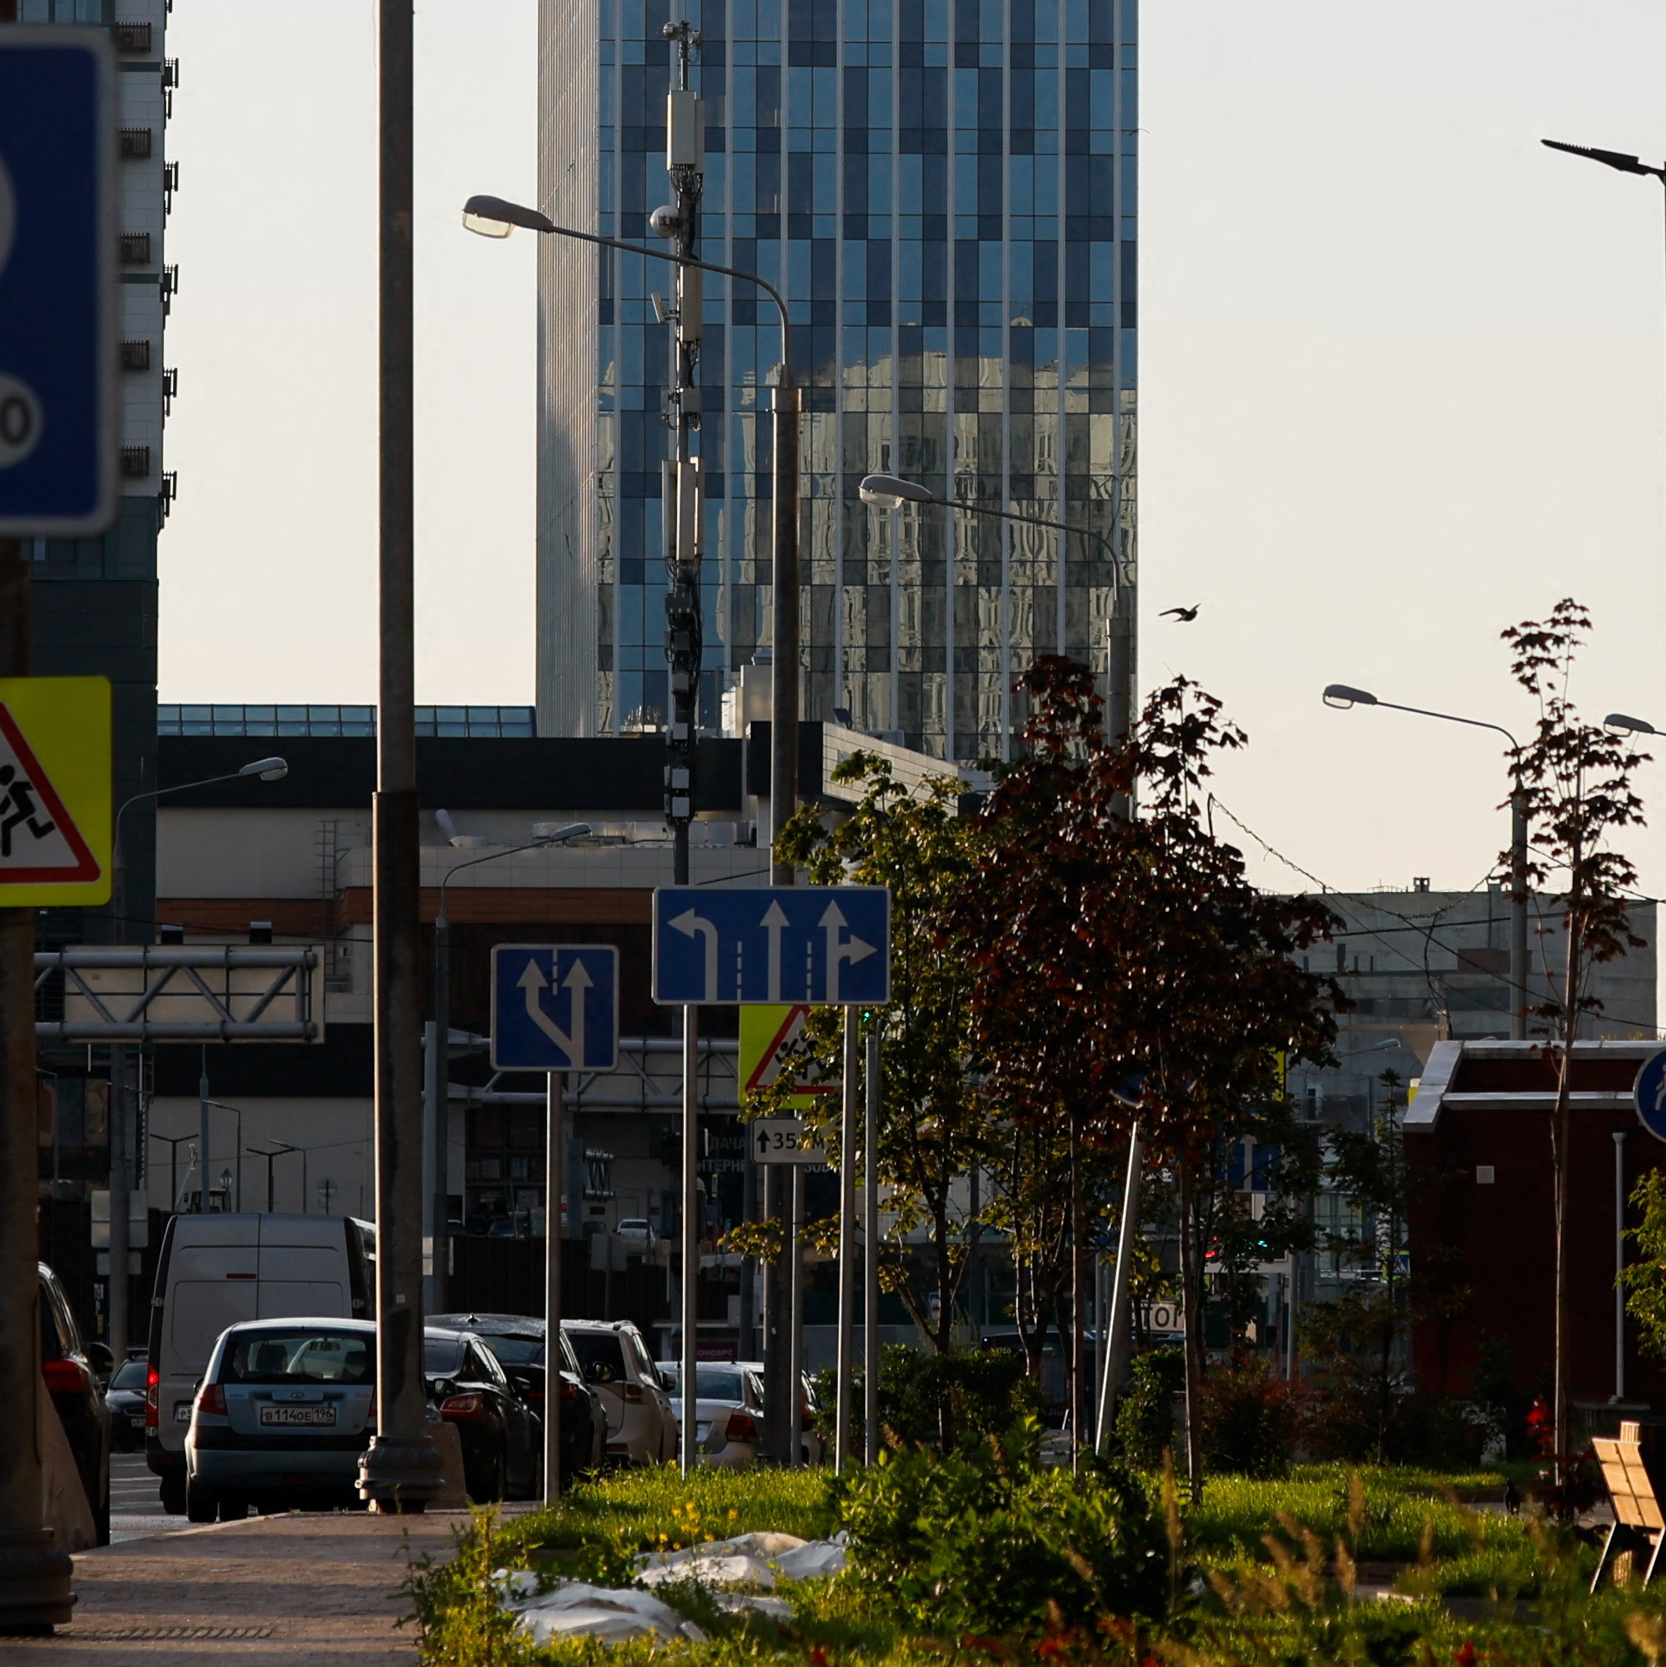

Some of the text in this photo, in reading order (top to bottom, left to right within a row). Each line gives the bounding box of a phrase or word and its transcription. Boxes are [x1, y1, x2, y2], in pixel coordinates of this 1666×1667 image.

[709, 1136, 746, 1152] ДАЧА
[773, 1132, 798, 1150] 35
[698, 1158, 747, 1173] НТЕРНЕ
